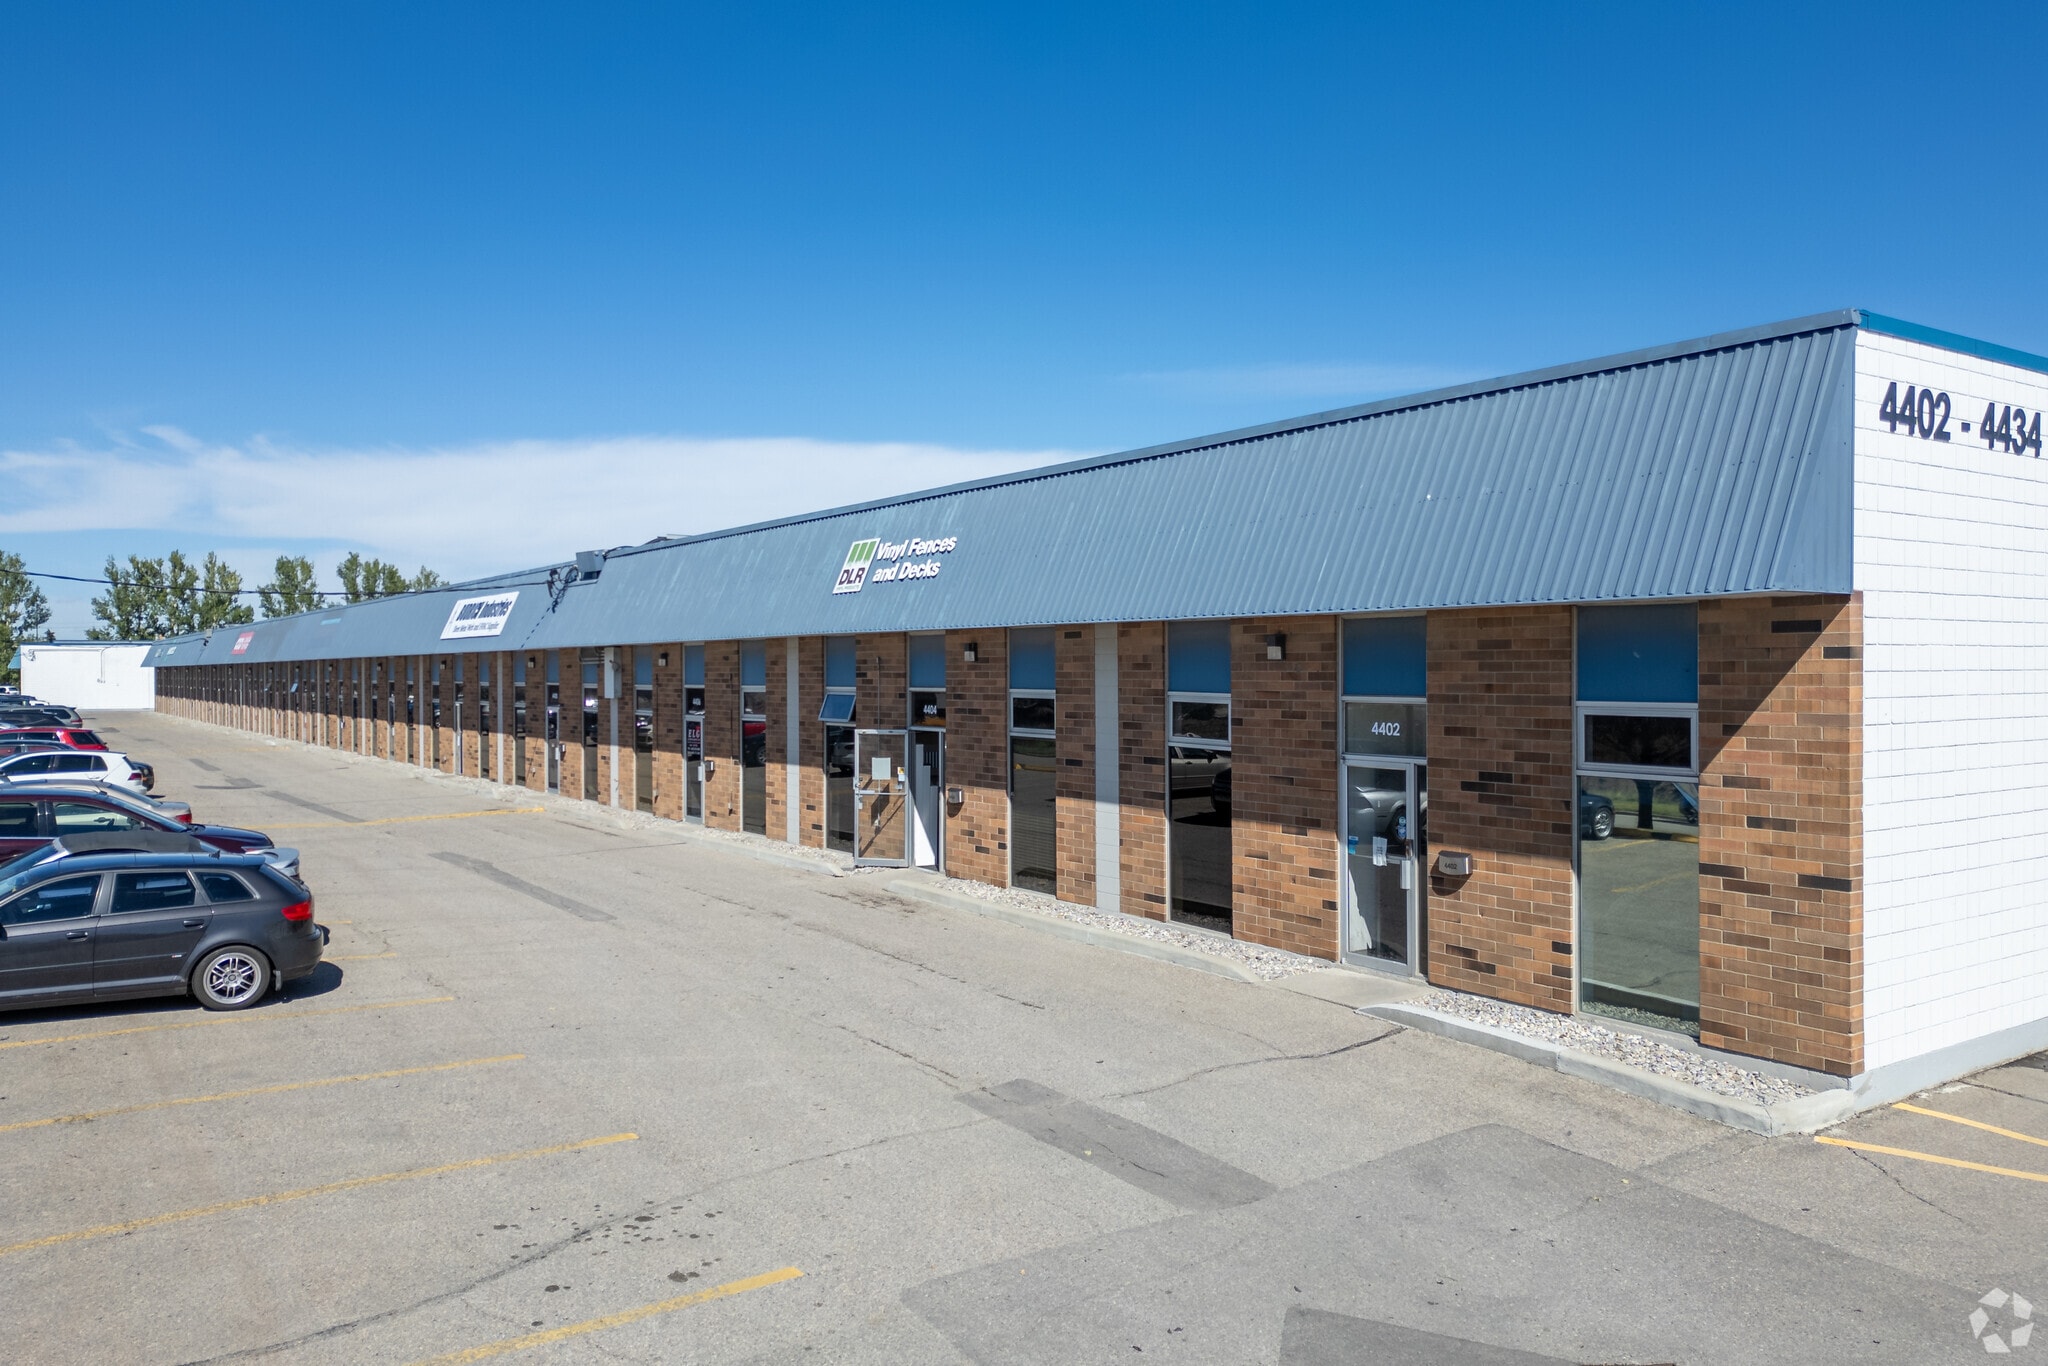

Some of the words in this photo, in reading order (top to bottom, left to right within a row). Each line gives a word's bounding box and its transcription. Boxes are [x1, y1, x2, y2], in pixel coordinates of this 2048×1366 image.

[1879, 381, 1951, 443] 4402
[1980, 402, 2042, 458] 4434
[876, 540, 909, 562] Vinyl
[907, 536, 958, 557] Fences
[838, 567, 866, 586] DLR
[872, 562, 900, 583] and
[898, 559, 941, 582] Decks
[1371, 721, 1401, 737] 4402
[1444, 862, 1458, 870] 4402
